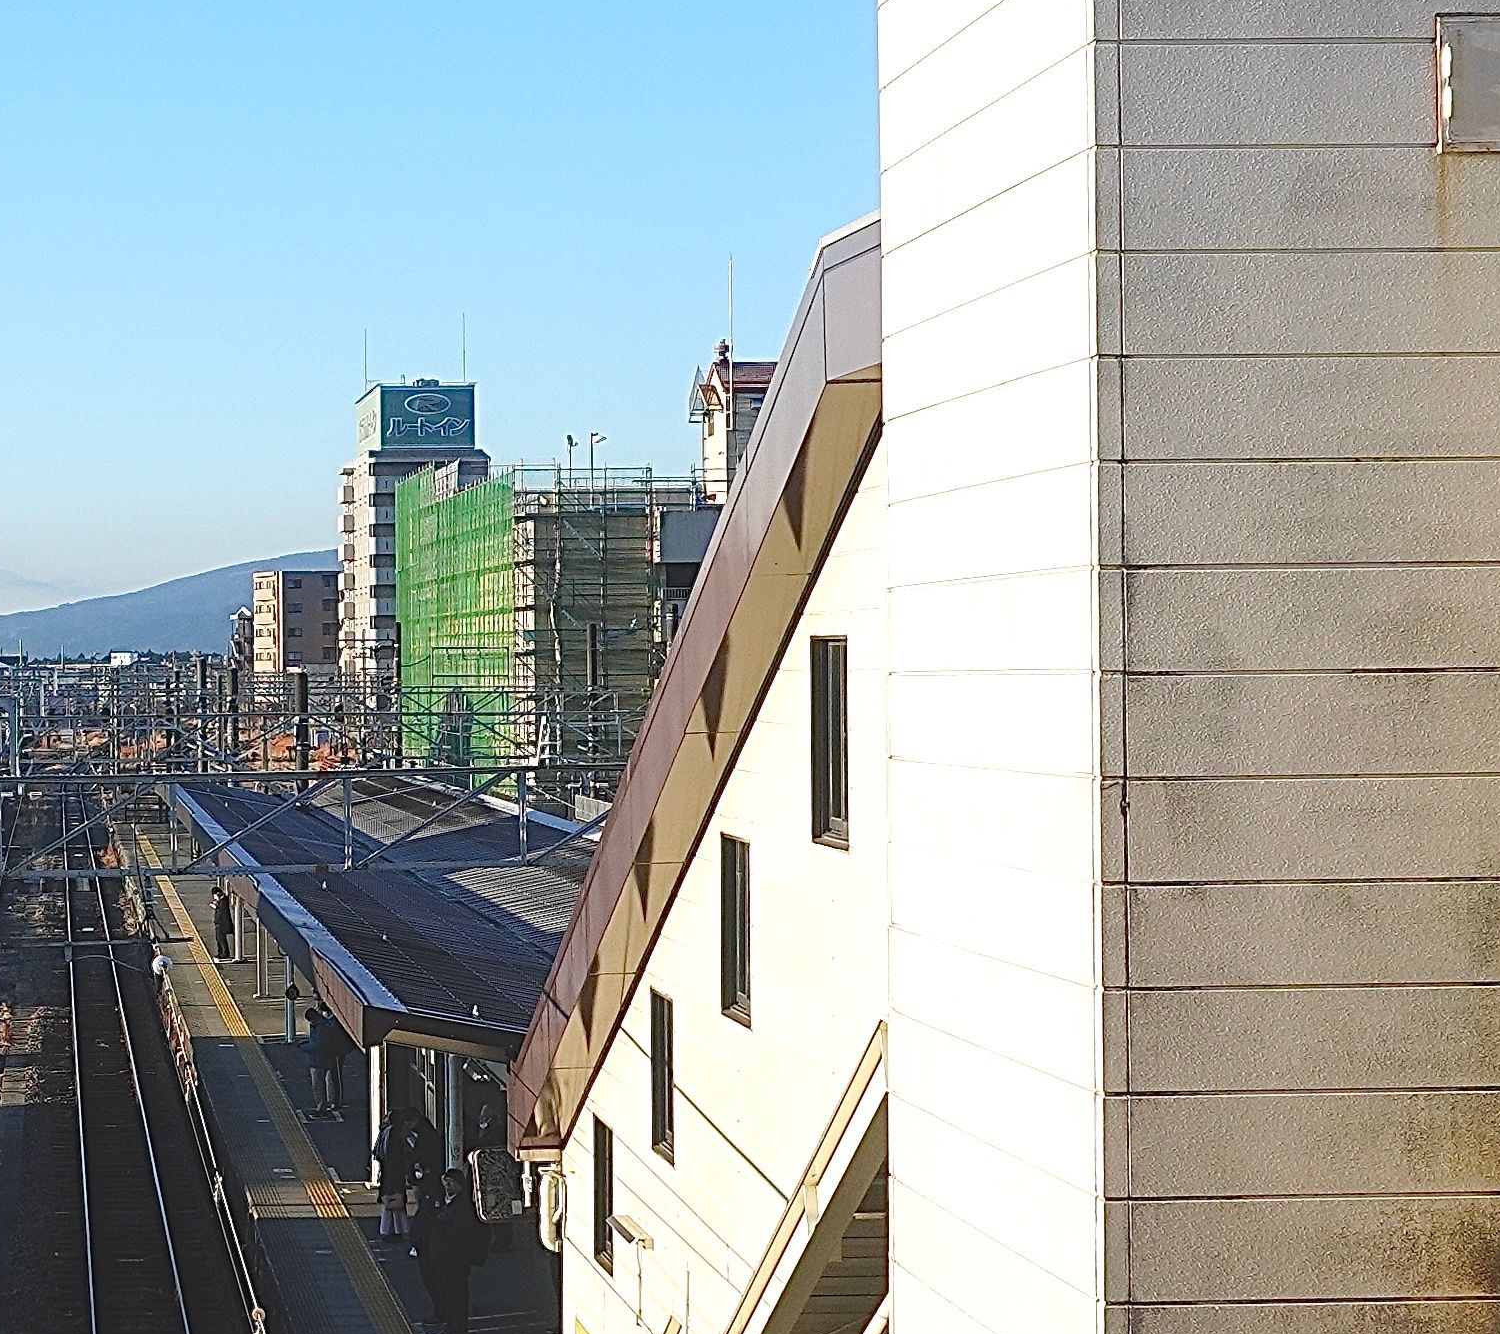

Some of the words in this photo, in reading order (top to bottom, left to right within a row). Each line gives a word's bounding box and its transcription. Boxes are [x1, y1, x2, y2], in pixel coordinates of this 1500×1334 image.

[387, 416, 471, 437] ルートイン
